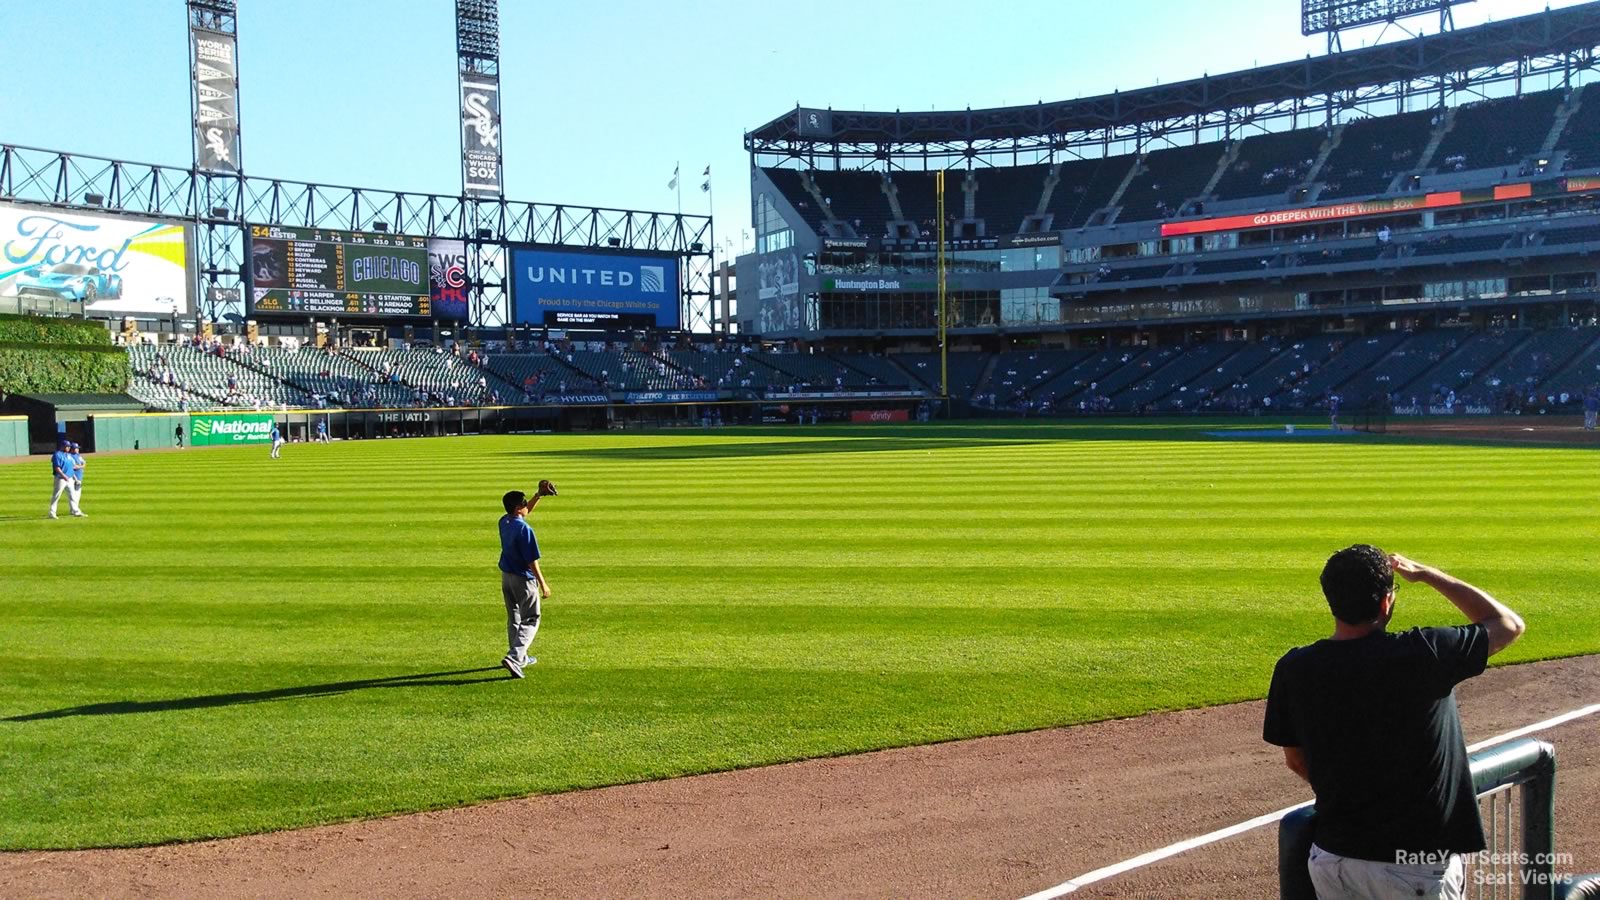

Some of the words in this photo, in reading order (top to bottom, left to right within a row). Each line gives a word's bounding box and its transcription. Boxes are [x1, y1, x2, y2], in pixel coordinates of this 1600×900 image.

[198, 39, 231, 51] WORLD
[198, 47, 231, 58] SERIES
[469, 160, 497, 168] WHITE
[469, 167, 497, 179] SOX
[1254, 215, 1269, 225] GO
[1270, 211, 1307, 223] DEEPER
[1309, 208, 1335, 219] WITH
[1336, 206, 1356, 216] THE
[1358, 204, 1390, 214] WHITE
[1393, 200, 1414, 210] SOX
[252, 226, 270, 237] 34
[270, 232, 297, 240] LESTER
[4, 216, 130, 271] Ford
[353, 256, 420, 285] CHICAGO
[528, 266, 634, 286] UNITED
[446, 266, 465, 288] C
[835, 280, 878, 291] Huntington
[879, 280, 900, 289] Bank
[538, 298, 561, 306] Proud
[572, 299, 584, 309] fly
[585, 299, 596, 308] the
[597, 300, 625, 310] Chicago
[625, 301, 647, 309] White
[561, 395, 608, 403] HYUNDAI
[628, 392, 663, 400] ATHLETICO
[1466, 405, 1491, 414] Modelo
[378, 414, 399, 422] THE
[870, 412, 891, 422] xfinity
[212, 419, 272, 435] National
